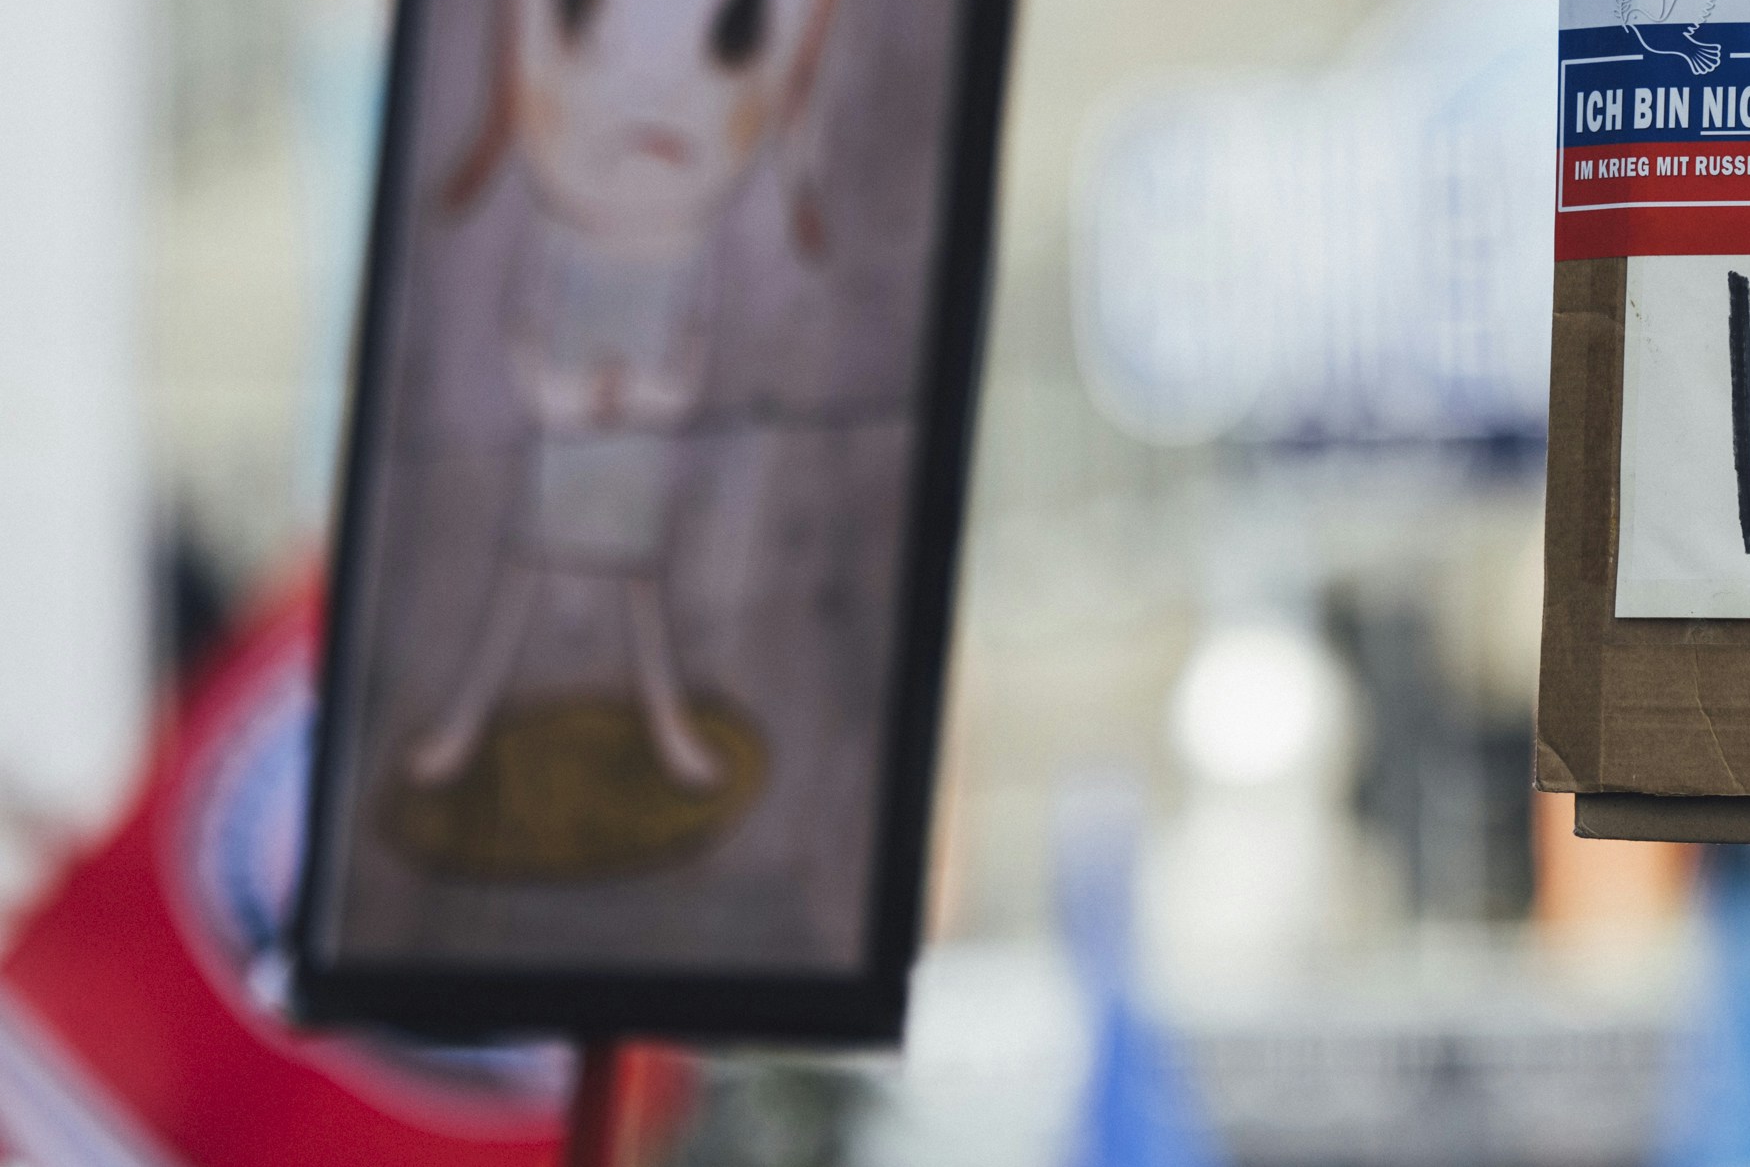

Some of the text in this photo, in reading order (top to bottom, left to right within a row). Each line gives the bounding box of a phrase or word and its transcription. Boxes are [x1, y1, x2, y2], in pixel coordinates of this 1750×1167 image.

[1576, 88, 1624, 133] ICH
[1633, 86, 1690, 130] BIN
[1574, 159, 1594, 181] IM
[1598, 156, 1650, 179] KRIEG
[1656, 155, 1690, 177] MIT
